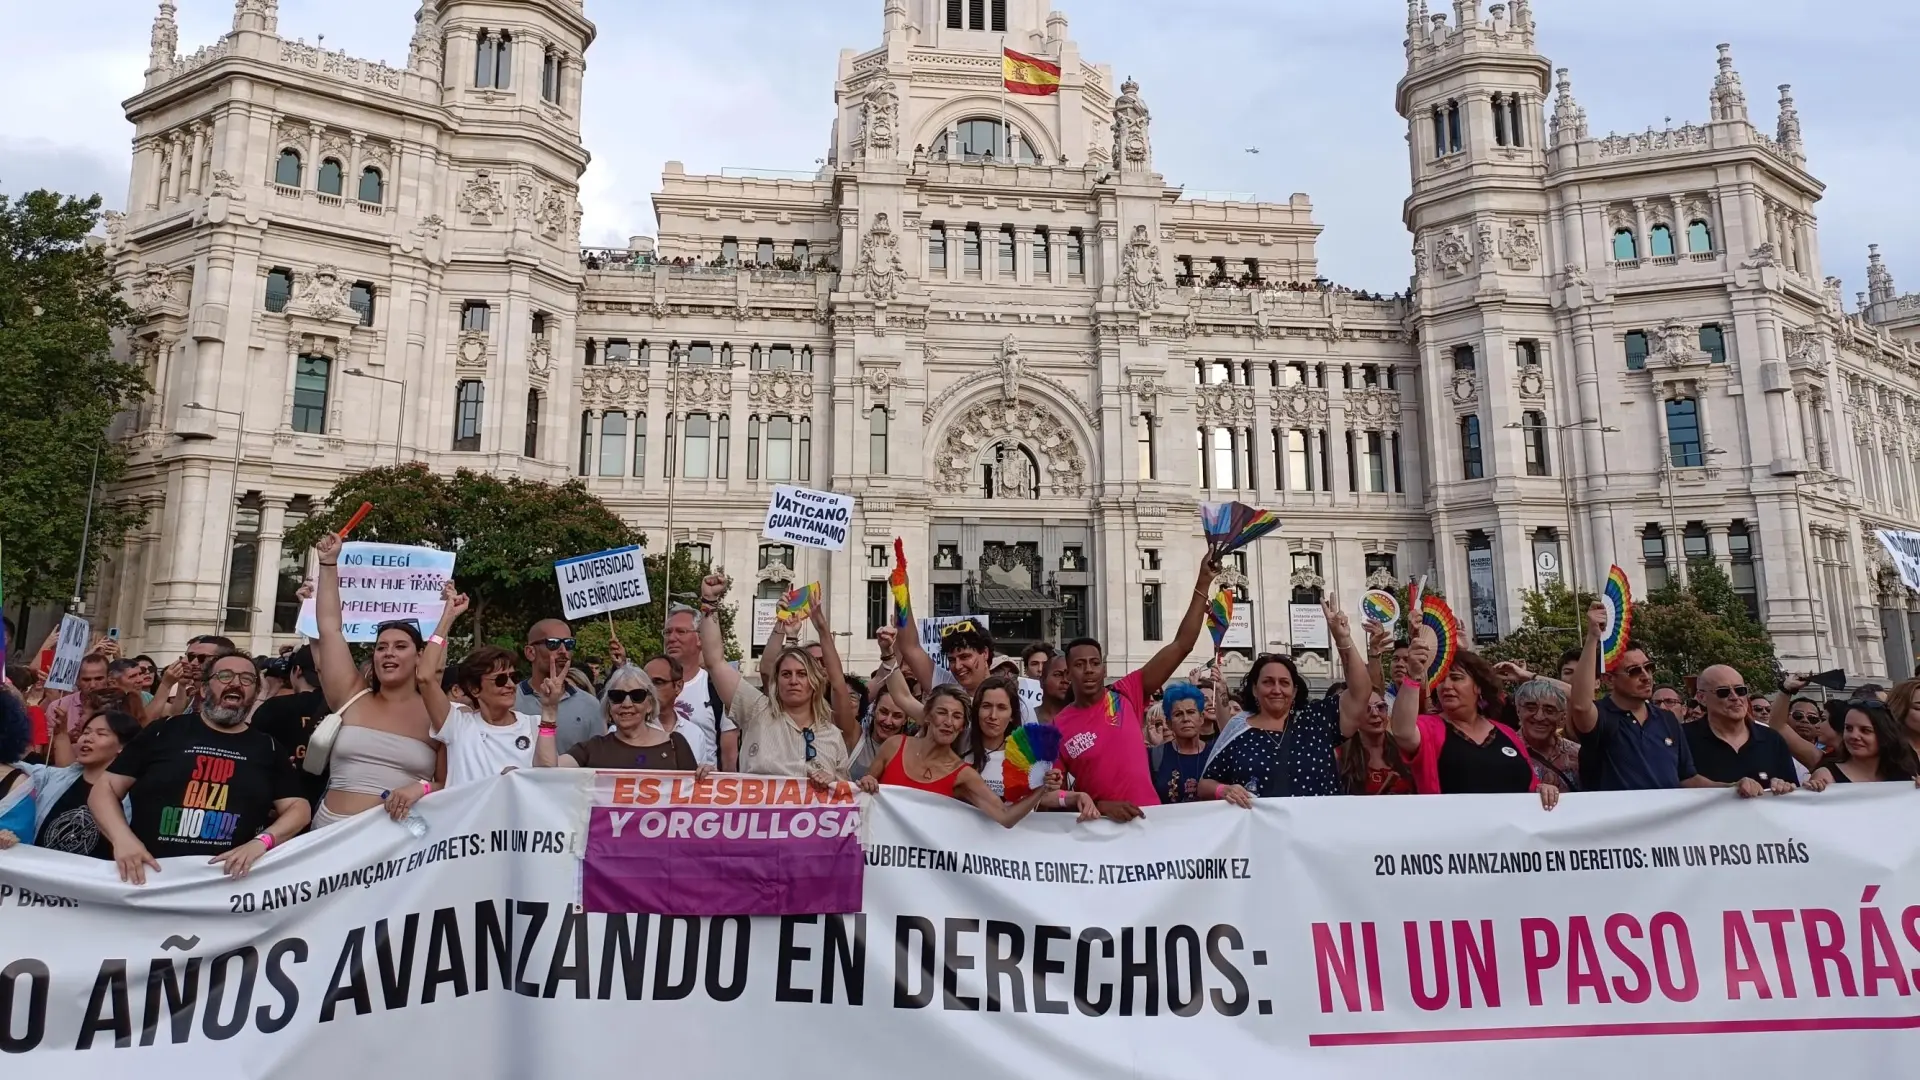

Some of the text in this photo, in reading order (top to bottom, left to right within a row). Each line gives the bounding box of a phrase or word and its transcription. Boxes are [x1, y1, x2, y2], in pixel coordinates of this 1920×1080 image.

[775, 492, 849, 525] VATICANO,
[795, 490, 827, 503] Cerrar
[768, 513, 845, 544] GUANTANAMO
[784, 531, 827, 546] mental.
[344, 553, 411, 567] NO ELEGÍ
[564, 553, 634, 583] LA DIVERSIDAD
[362, 578, 377, 589] UN
[381, 579, 406, 590] HIJE
[410, 579, 444, 592] TRANS
[566, 578, 644, 611] NOS ENRIQUECE.
[341, 600, 424, 614] MPLEMENTE...
[192, 754, 235, 783] STOP
[182, 780, 229, 811] GAZA
[612, 777, 854, 805] ES LESBIANA
[159, 805, 240, 841] GENOCIDE
[609, 811, 863, 839] Y ORGULLOSA
[230, 892, 256, 914] 20
[261, 881, 312, 911] ANYS
[317, 857, 406, 898] AVANÇANT
[405, 849, 428, 873] EN
[426, 833, 485, 864] DRETS:
[490, 829, 508, 853] NI
[511, 829, 528, 853] UN
[531, 830, 565, 854] PAS
[962, 852, 1032, 881] AURRERA
[1035, 861, 1094, 884] EGINEZ:
[1098, 858, 1228, 885] ATZERAPAUSORIK
[1231, 858, 1251, 879] EZ
[1374, 838, 1810, 876] 20 ANOS AVANZANDO EN DEREITOS: NIN UN PASO ATRÁS
[75, 934, 309, 1050] AÑOS
[319, 898, 751, 1023] AVANZANDO
[775, 912, 867, 1006] EN
[893, 914, 1273, 1017] DERECHOS:
[1311, 921, 1385, 1014] NI
[1403, 919, 1502, 1011] UN
[1520, 911, 1700, 1007] PASO
